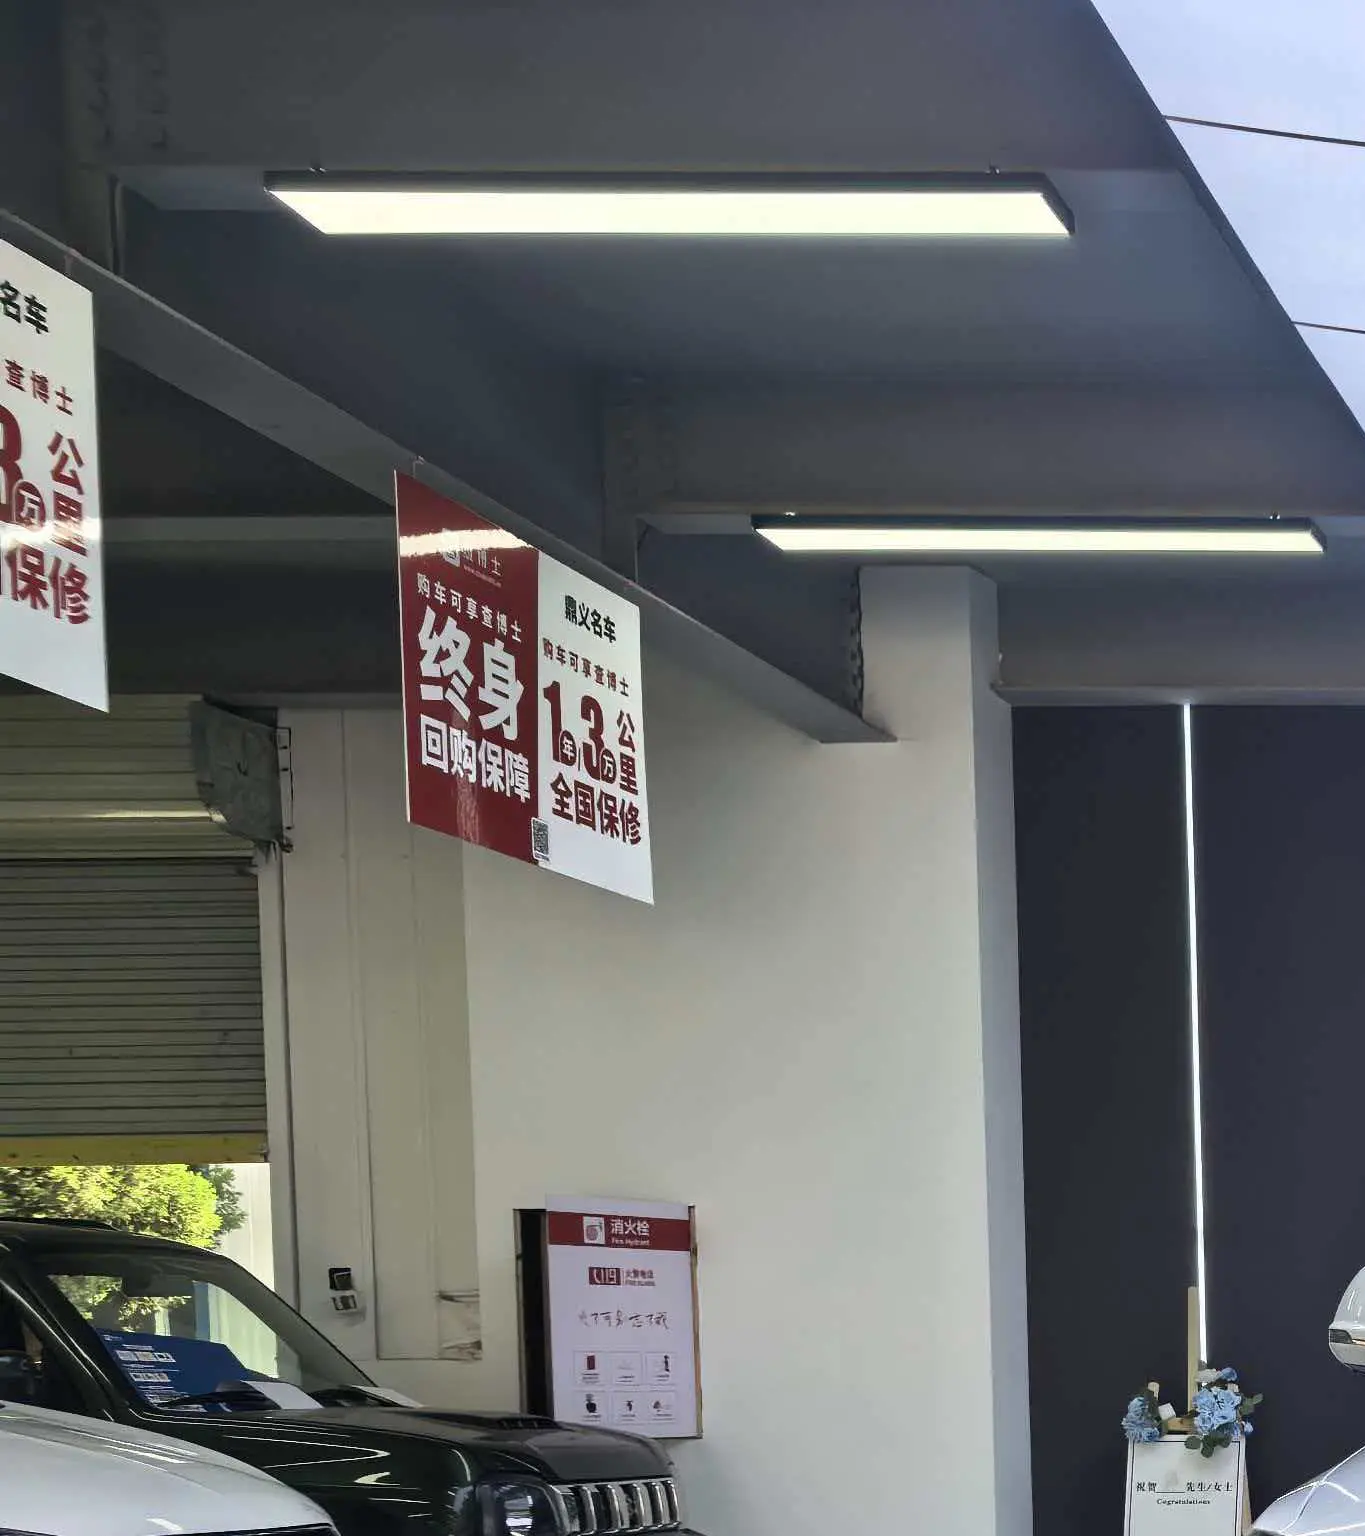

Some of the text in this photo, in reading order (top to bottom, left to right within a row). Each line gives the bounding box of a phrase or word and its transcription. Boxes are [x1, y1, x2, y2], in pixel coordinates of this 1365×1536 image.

[0, 540, 91, 626] 保修
[416, 572, 522, 643] 购车可享查博士
[564, 594, 617, 645] 鼎义名车
[418, 604, 525, 741] 终身
[542, 636, 630, 698] 购车可享查博士
[419, 713, 531, 803] 回购保障
[550, 772, 642, 846] 全国保修
[610, 1218, 650, 1236] 消火栓
